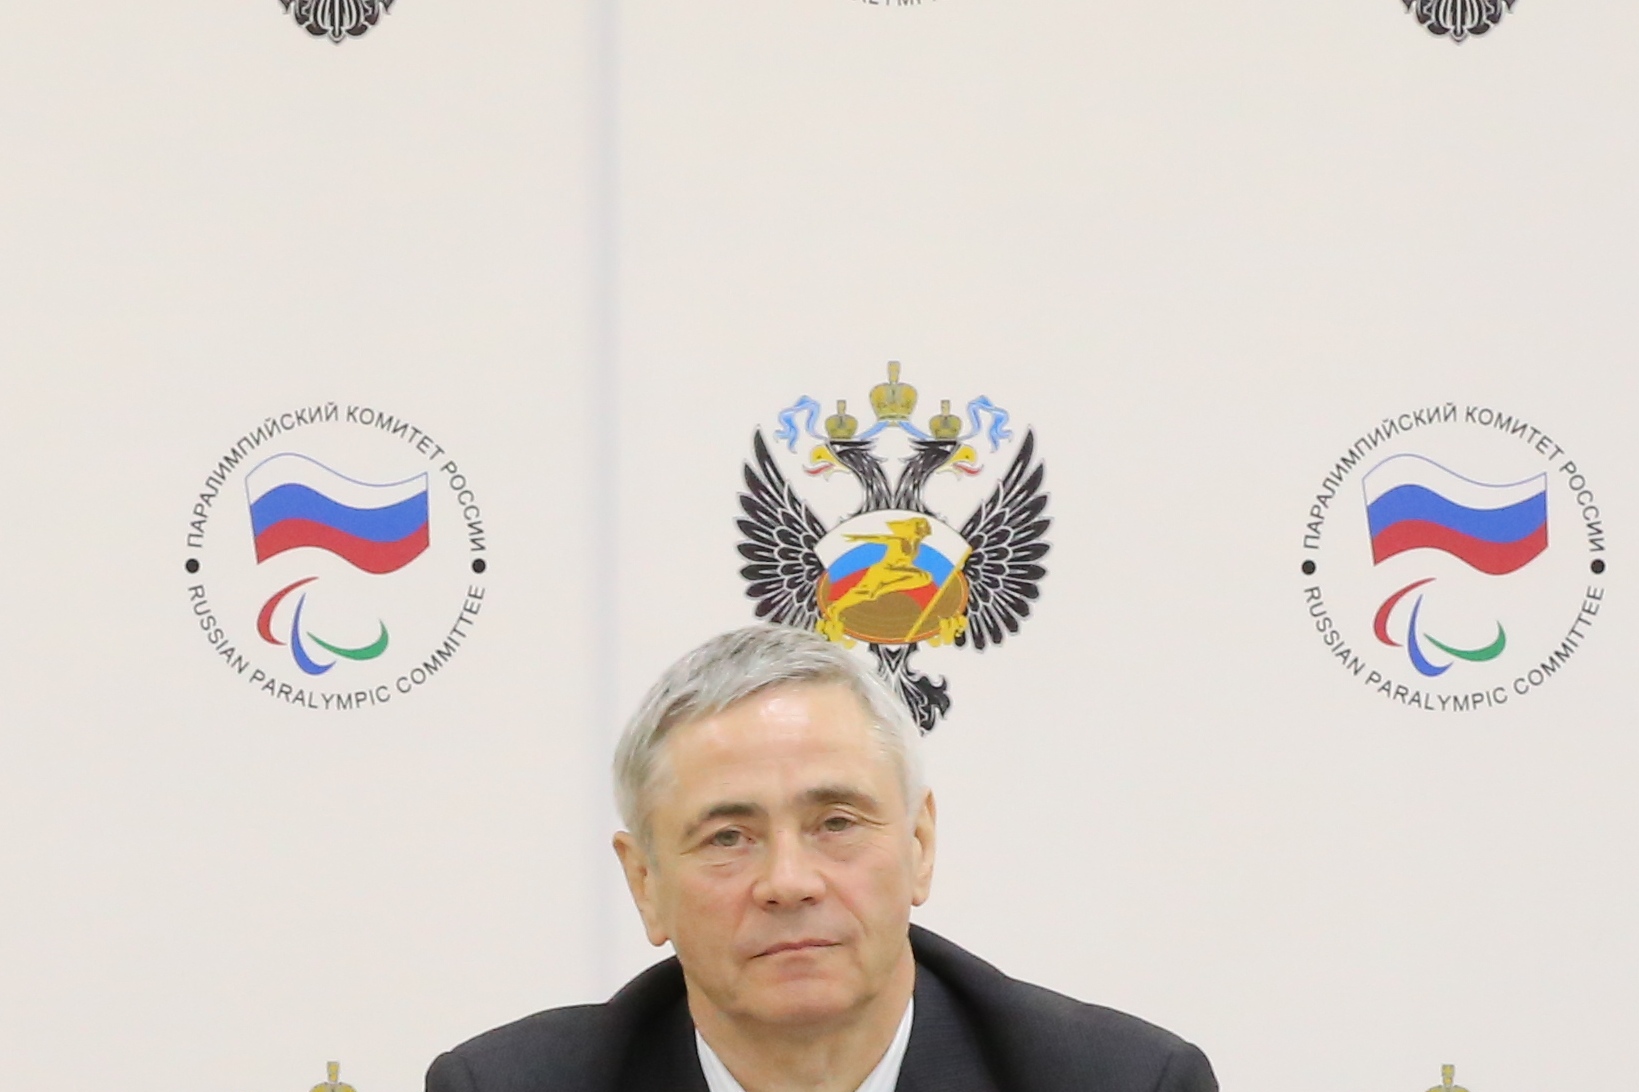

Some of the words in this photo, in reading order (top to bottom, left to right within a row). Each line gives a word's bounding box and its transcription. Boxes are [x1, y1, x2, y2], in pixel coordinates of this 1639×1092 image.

[187, 402, 338, 548] ПАРАЛИМПИЙСКИЙ
[346, 405, 445, 461] КОМИТЕТ
[440, 460, 486, 551] РОССИИ
[1303, 402, 1458, 549] ПАРАЛИМПИЙСКИЙ
[1465, 406, 1564, 461] КОМИТЕТ
[1559, 460, 1605, 552] РОССИИ
[188, 584, 250, 674] RUSSIAN
[249, 669, 391, 710] PARALYMPIC
[397, 584, 486, 693] COMMITTEE
[1304, 586, 1365, 676] RUSSIAN
[1365, 670, 1509, 712] PARALYMPIC
[1514, 585, 1604, 694] COMMITTEE
